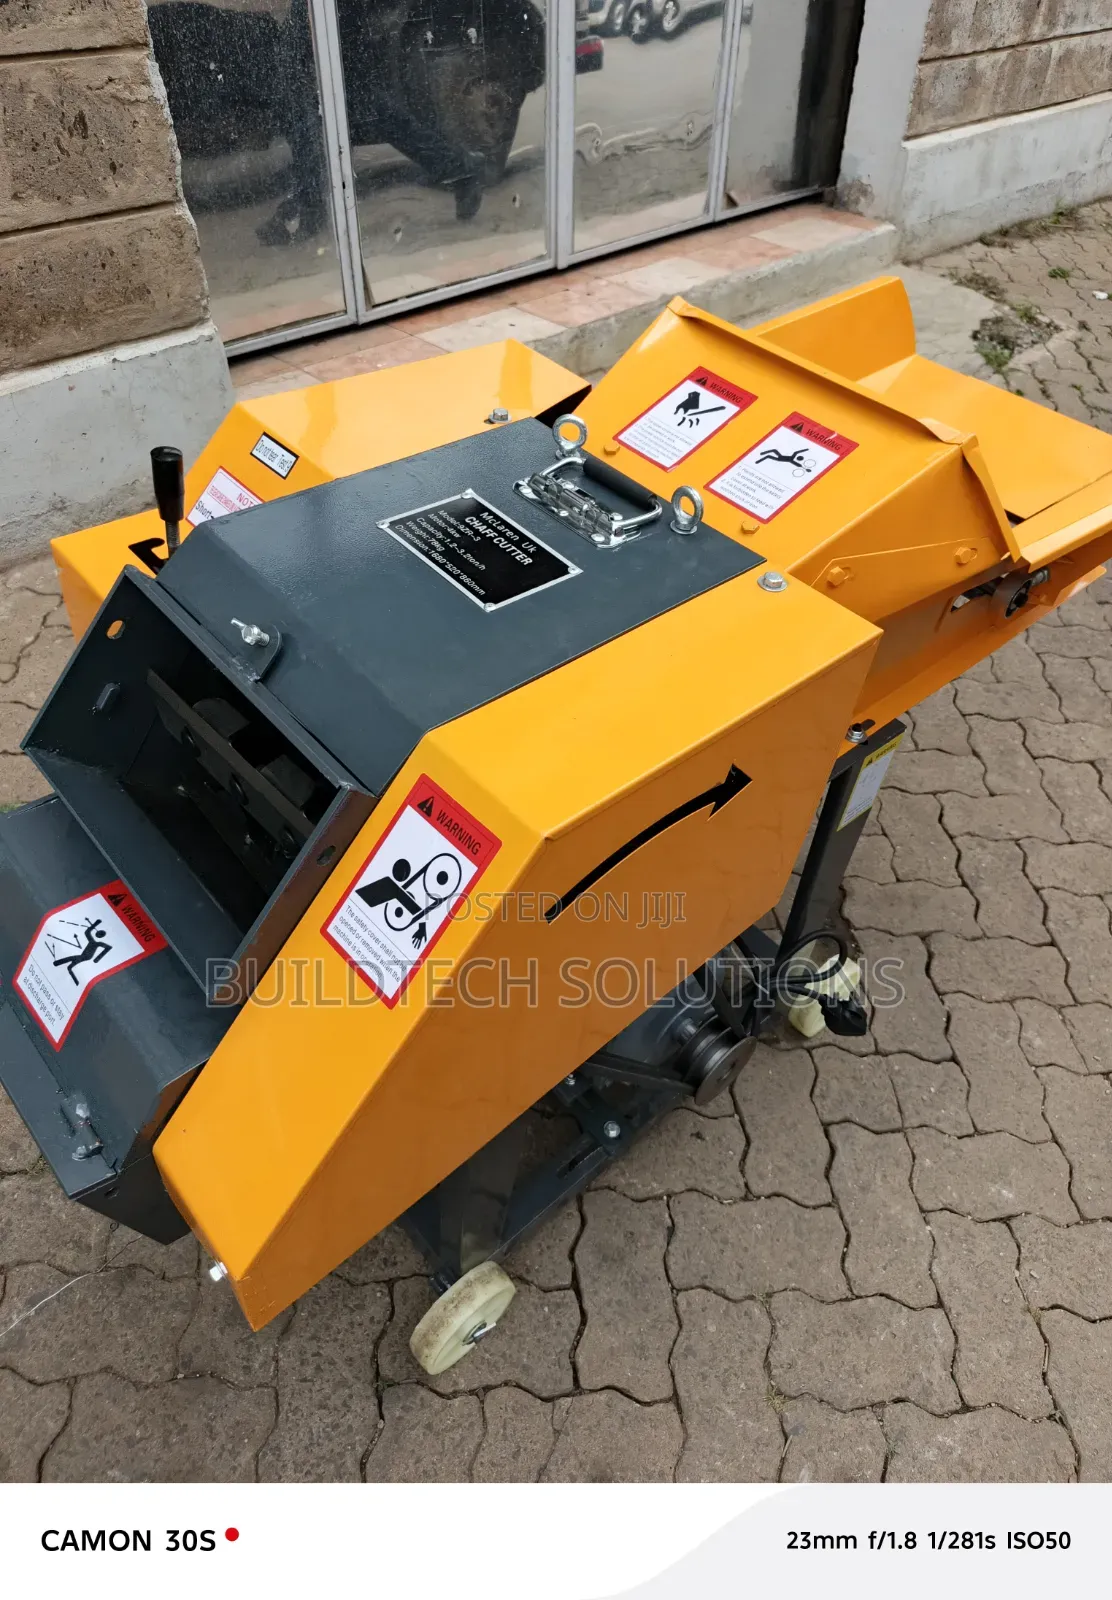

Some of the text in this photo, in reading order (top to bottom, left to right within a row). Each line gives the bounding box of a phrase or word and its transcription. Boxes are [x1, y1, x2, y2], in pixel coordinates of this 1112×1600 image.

[709, 381, 743, 404] WARNING
[806, 428, 842, 451] WARNING
[464, 516, 533, 566] CHAFF CUTTER
[480, 512, 538, 554] McLaren Uk
[436, 809, 482, 856] WARNING
[121, 904, 157, 943] WARNING
[332, 922, 353, 947] machine
[338, 913, 357, 936] opened
[359, 936, 381, 961] removed
[344, 904, 356, 918] The
[352, 914, 369, 933] safety
[366, 928, 381, 945] cover
[379, 941, 393, 957] shall
